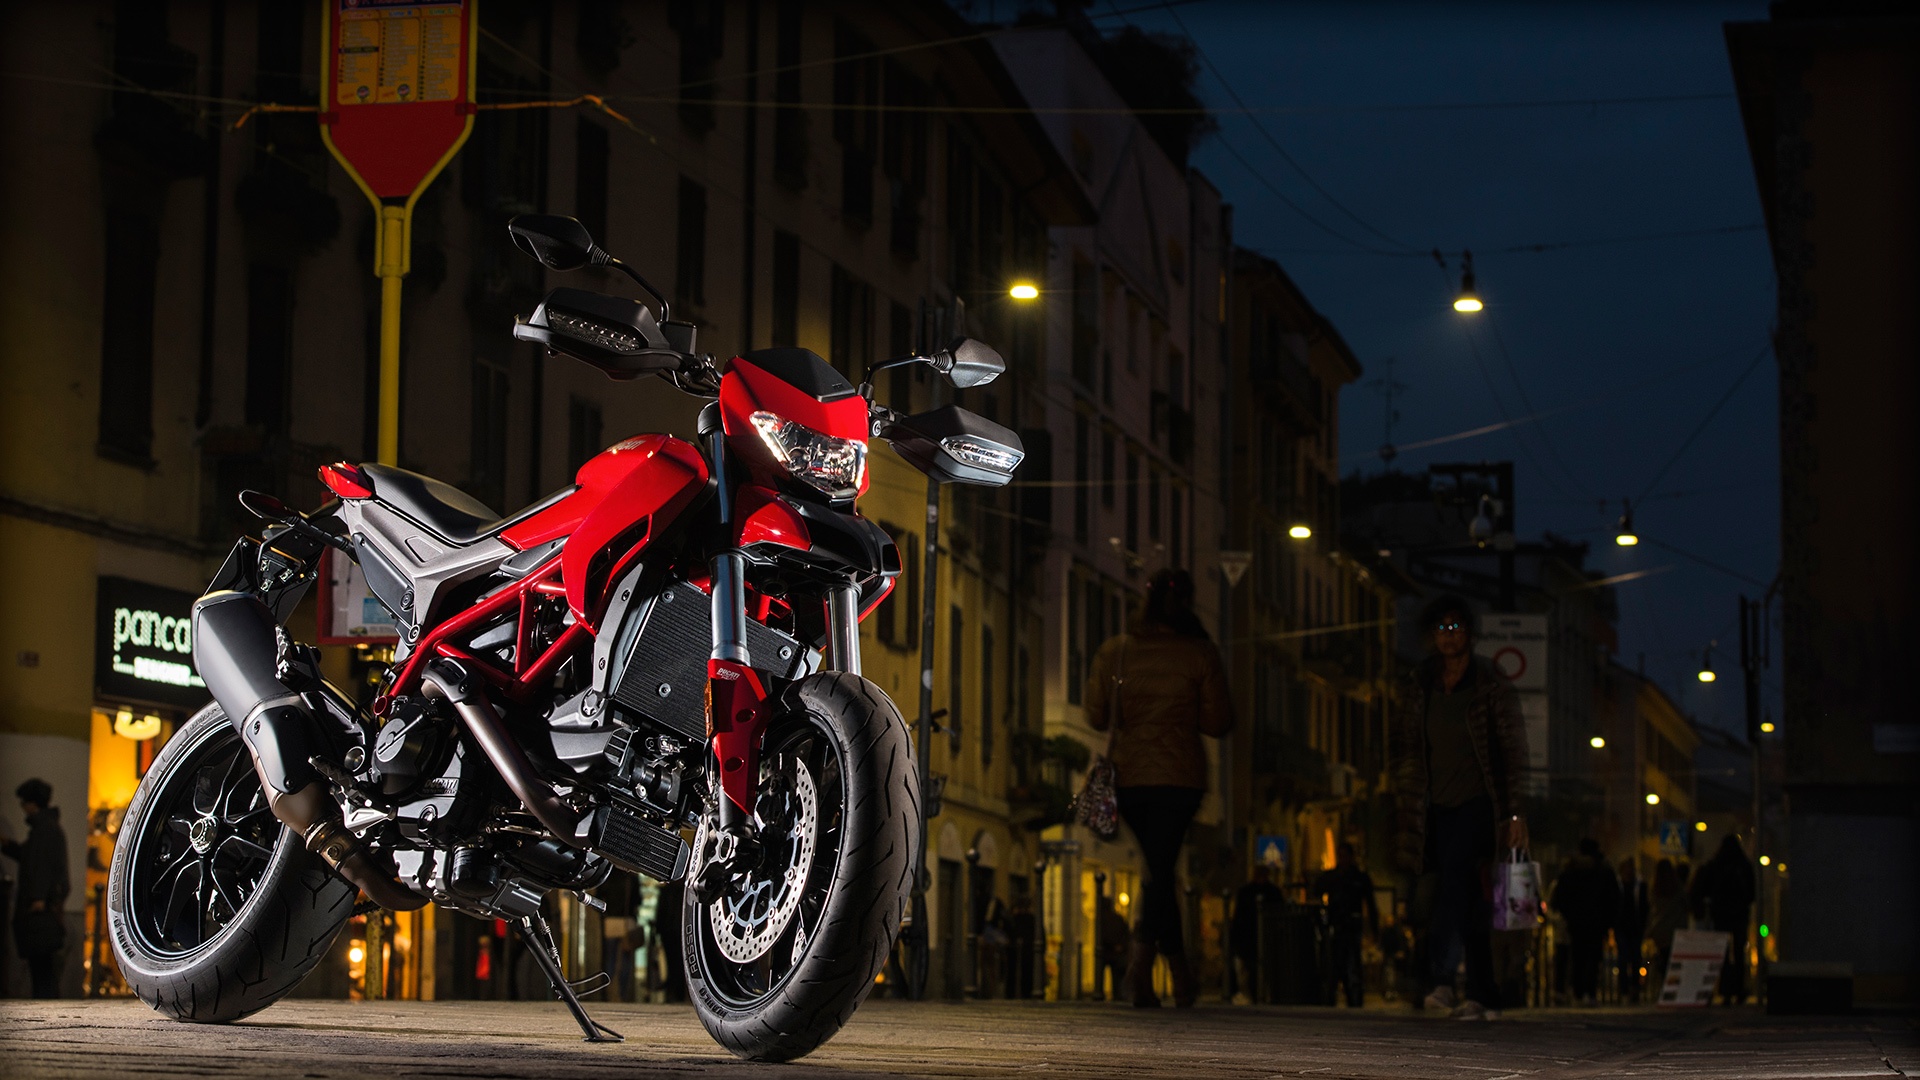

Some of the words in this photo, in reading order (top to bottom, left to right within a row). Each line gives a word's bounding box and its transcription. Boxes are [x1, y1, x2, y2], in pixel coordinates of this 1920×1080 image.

[716, 667, 740, 679] DUCATI
[424, 779, 458, 789] DUCATI
[112, 852, 123, 903] ROSSO
[113, 918, 136, 960] DIABLO
[685, 923, 699, 974] ROSSO
[699, 987, 728, 1019] DIABLO
